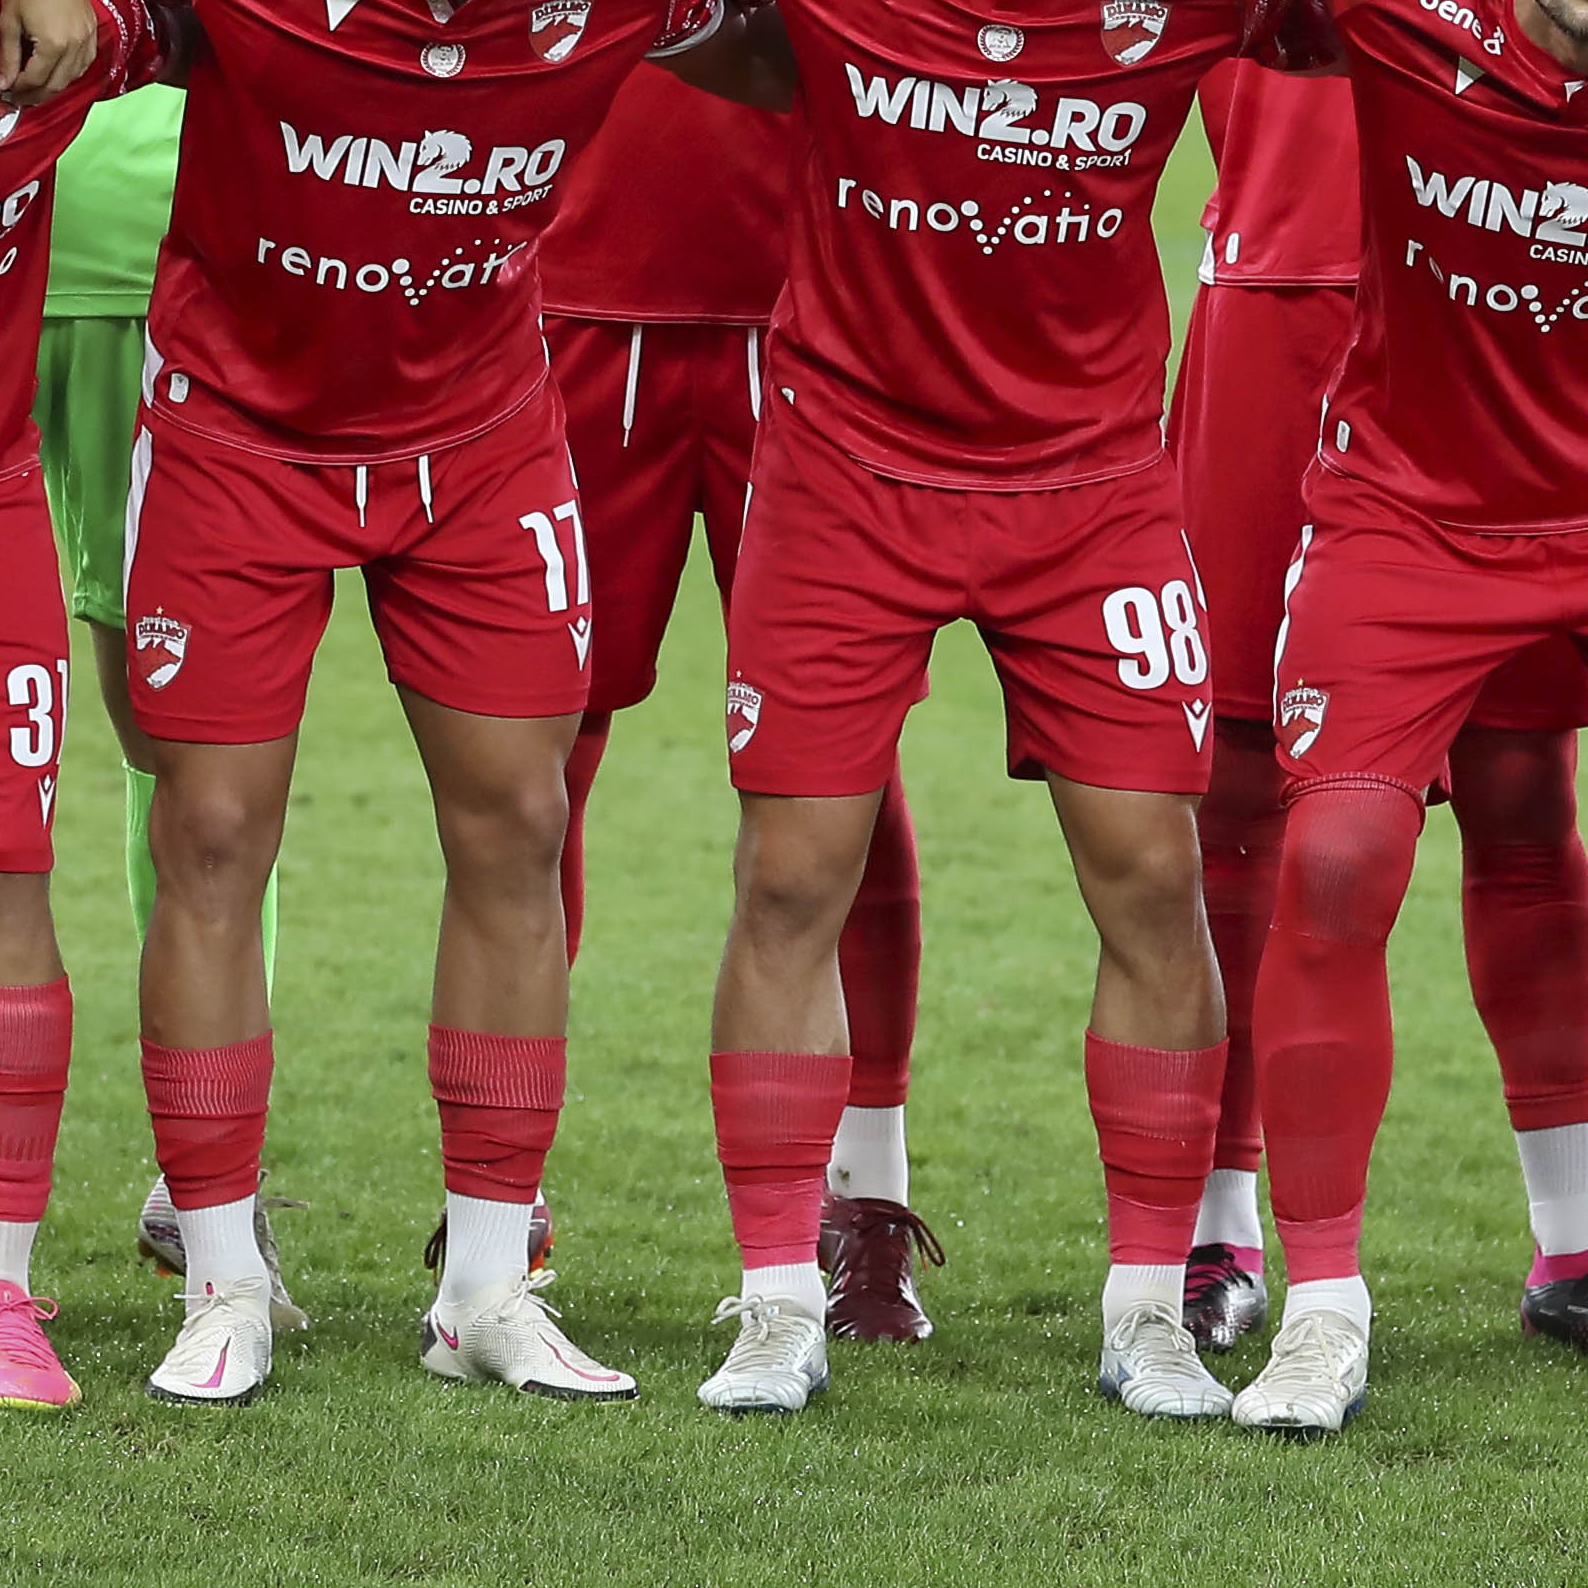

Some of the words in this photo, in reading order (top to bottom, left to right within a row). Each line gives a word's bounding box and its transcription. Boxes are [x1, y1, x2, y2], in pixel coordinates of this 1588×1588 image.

[535, 1, 589, 21] DINAMO
[844, 62, 1147, 152] WIN2.RO
[280, 120, 567, 196] WIN2.RO
[976, 143, 1053, 168] CASINO
[1055, 152, 1070, 170] &
[1074, 147, 1132, 170] SPORT
[409, 197, 483, 215] CASINO
[486, 199, 499, 214] &
[502, 185, 553, 212] SPORT
[258, 236, 530, 306] renovat
[1102, 579, 1210, 689] 98
